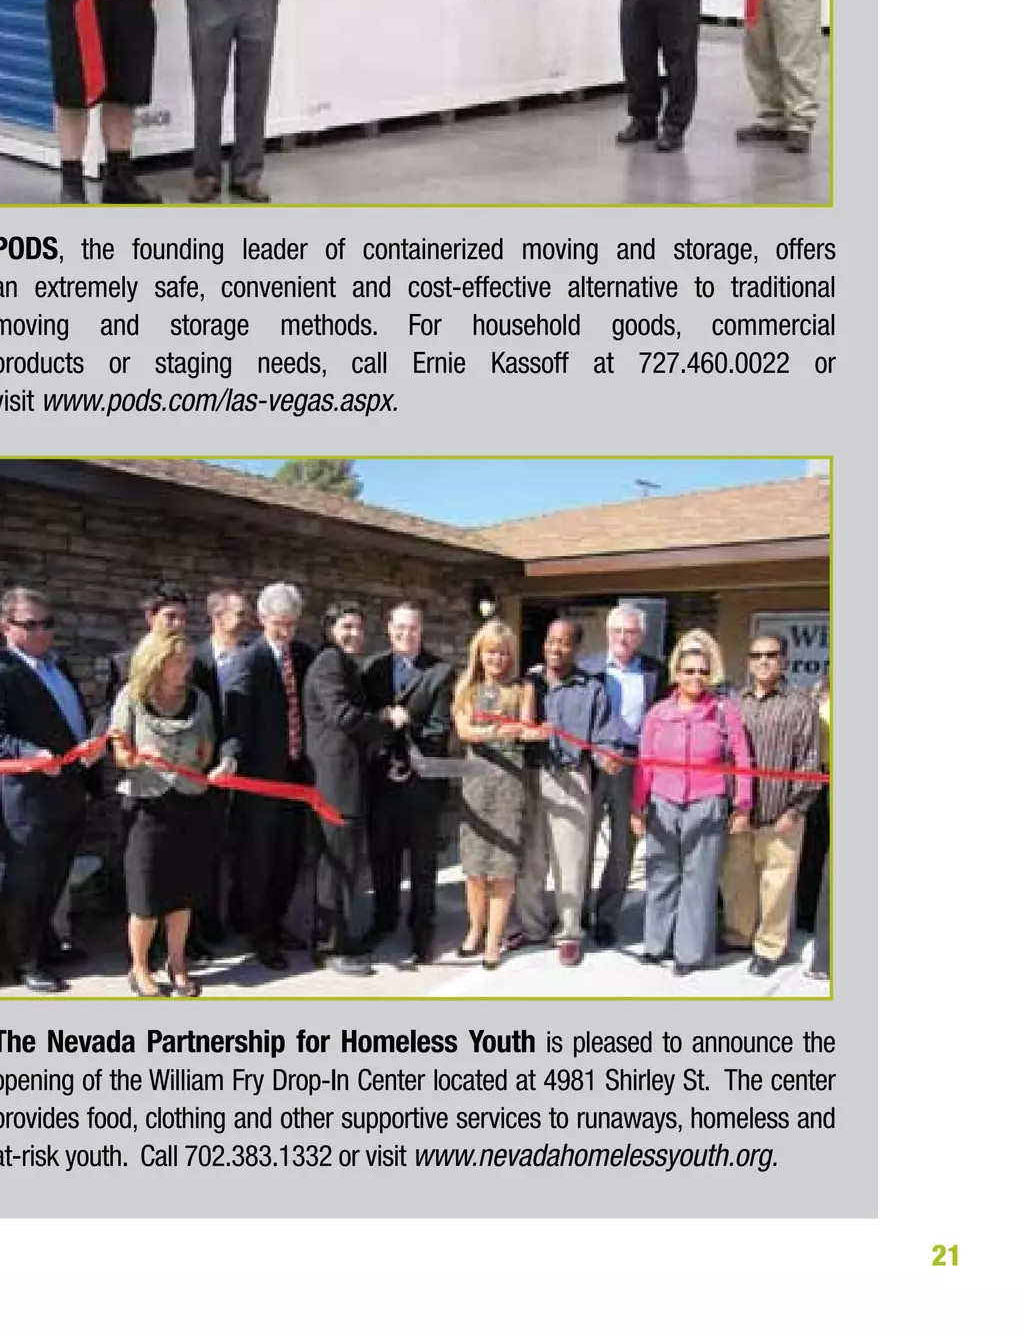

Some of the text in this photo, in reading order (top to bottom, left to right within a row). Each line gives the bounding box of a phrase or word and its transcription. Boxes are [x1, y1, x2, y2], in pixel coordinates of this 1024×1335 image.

[80, 237, 115, 261] the
[131, 237, 224, 266] founding
[242, 237, 309, 261] leader
[325, 237, 347, 261] of
[362, 237, 504, 261] containerized
[522, 237, 599, 266] moving
[616, 237, 656, 261] and
[673, 237, 759, 266] storage,
[775, 237, 837, 261] offers
[108, 355, 132, 374] or
[154, 351, 232, 380] staging
[257, 351, 327, 378] needs,
[351, 351, 387, 375] call
[413, 351, 466, 375] Ernie
[491, 350, 570, 375] Kassoff
[593, 351, 615, 375] at
[638, 351, 790, 375] 727.460.0022
[814, 355, 837, 375] or
[43, 387, 398, 418] www.pods.com/las-vegas.aspx.
[47, 1029, 136, 1054] Nevada
[147, 1028, 286, 1059] Partnership
[295, 1028, 331, 1054] for
[341, 1028, 458, 1054] Homeless
[468, 1029, 536, 1054] Youth
[546, 1030, 564, 1054] is
[573, 1030, 653, 1059] pleased
[661, 1031, 683, 1054] to
[691, 1035, 794, 1054] announce
[802, 1030, 836, 1054] the
[64, 1144, 128, 1172] youth.
[140, 1143, 178, 1168] Call
[184, 1144, 333, 1168] 702.383.1332
[338, 1149, 361, 1168] or
[365, 1144, 408, 1168] visit
[415, 1142, 778, 1173] www.nevadahomelessyouth.org.
[931, 1244, 958, 1267] 21
